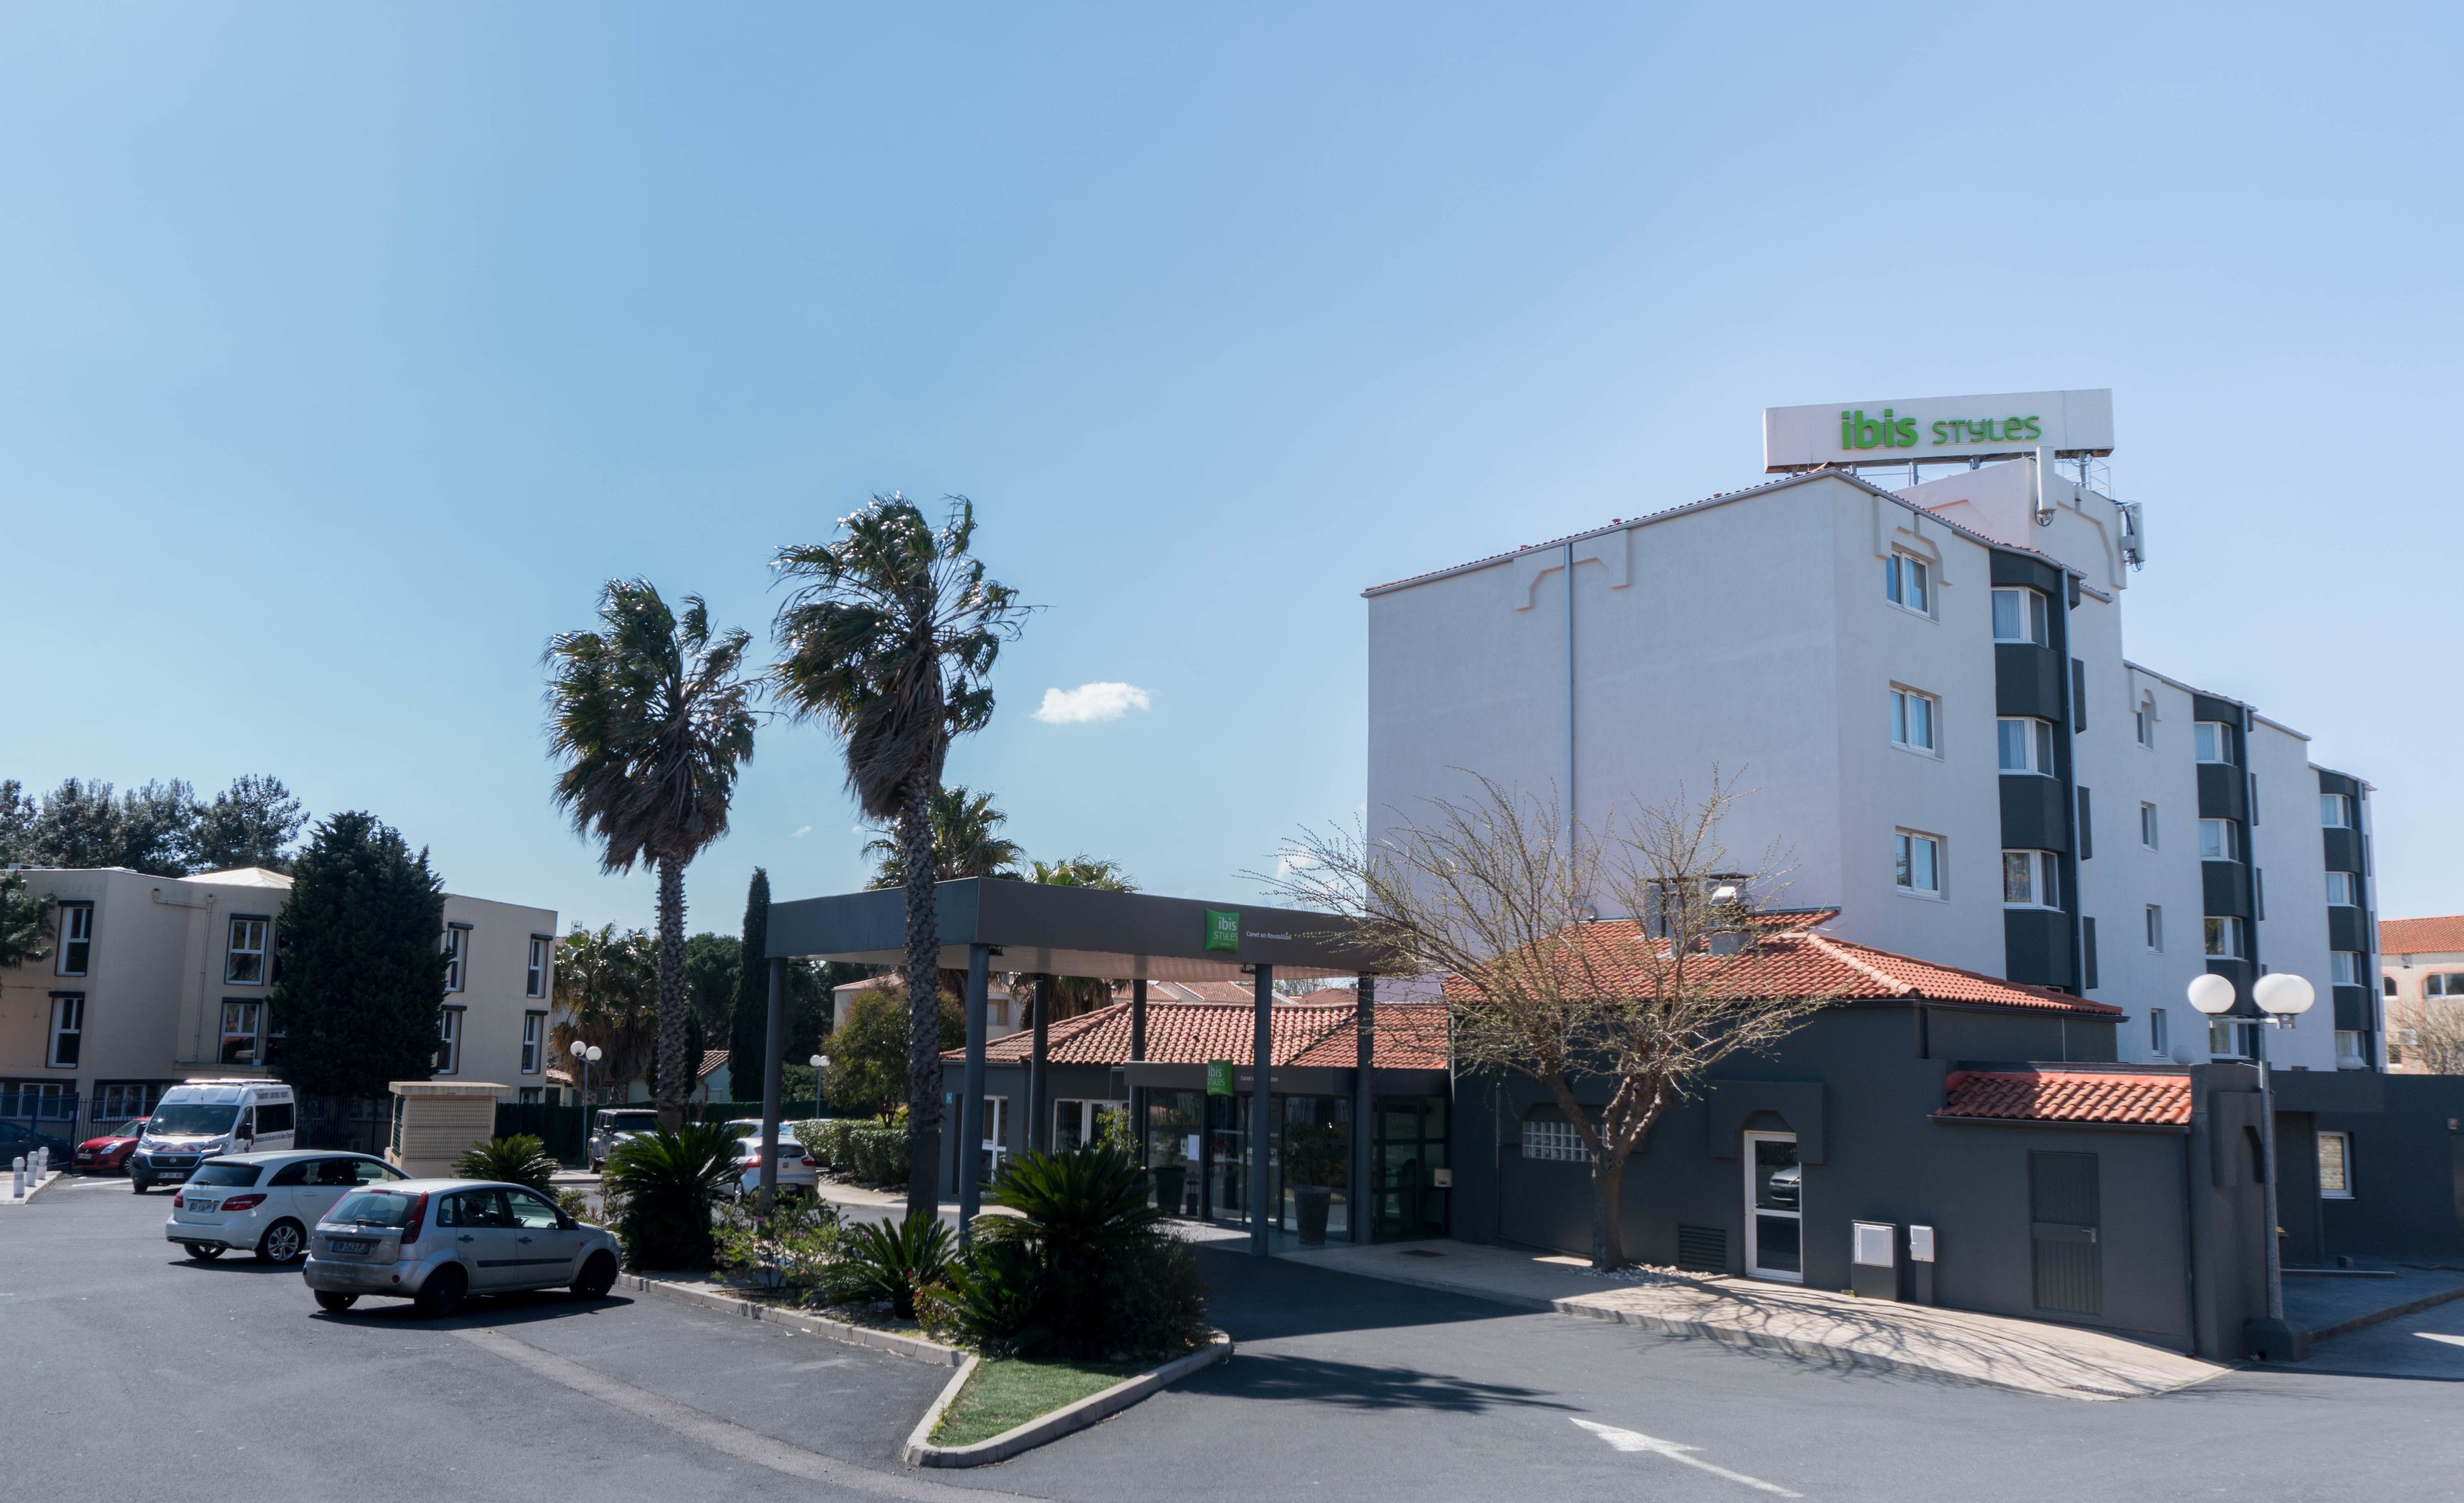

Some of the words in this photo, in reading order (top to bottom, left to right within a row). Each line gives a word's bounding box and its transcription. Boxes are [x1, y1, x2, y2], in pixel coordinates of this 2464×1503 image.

[1841, 409, 1918, 449] ibis
[1219, 917, 1236, 931] ibis
[1208, 1065, 1222, 1077] ibis
